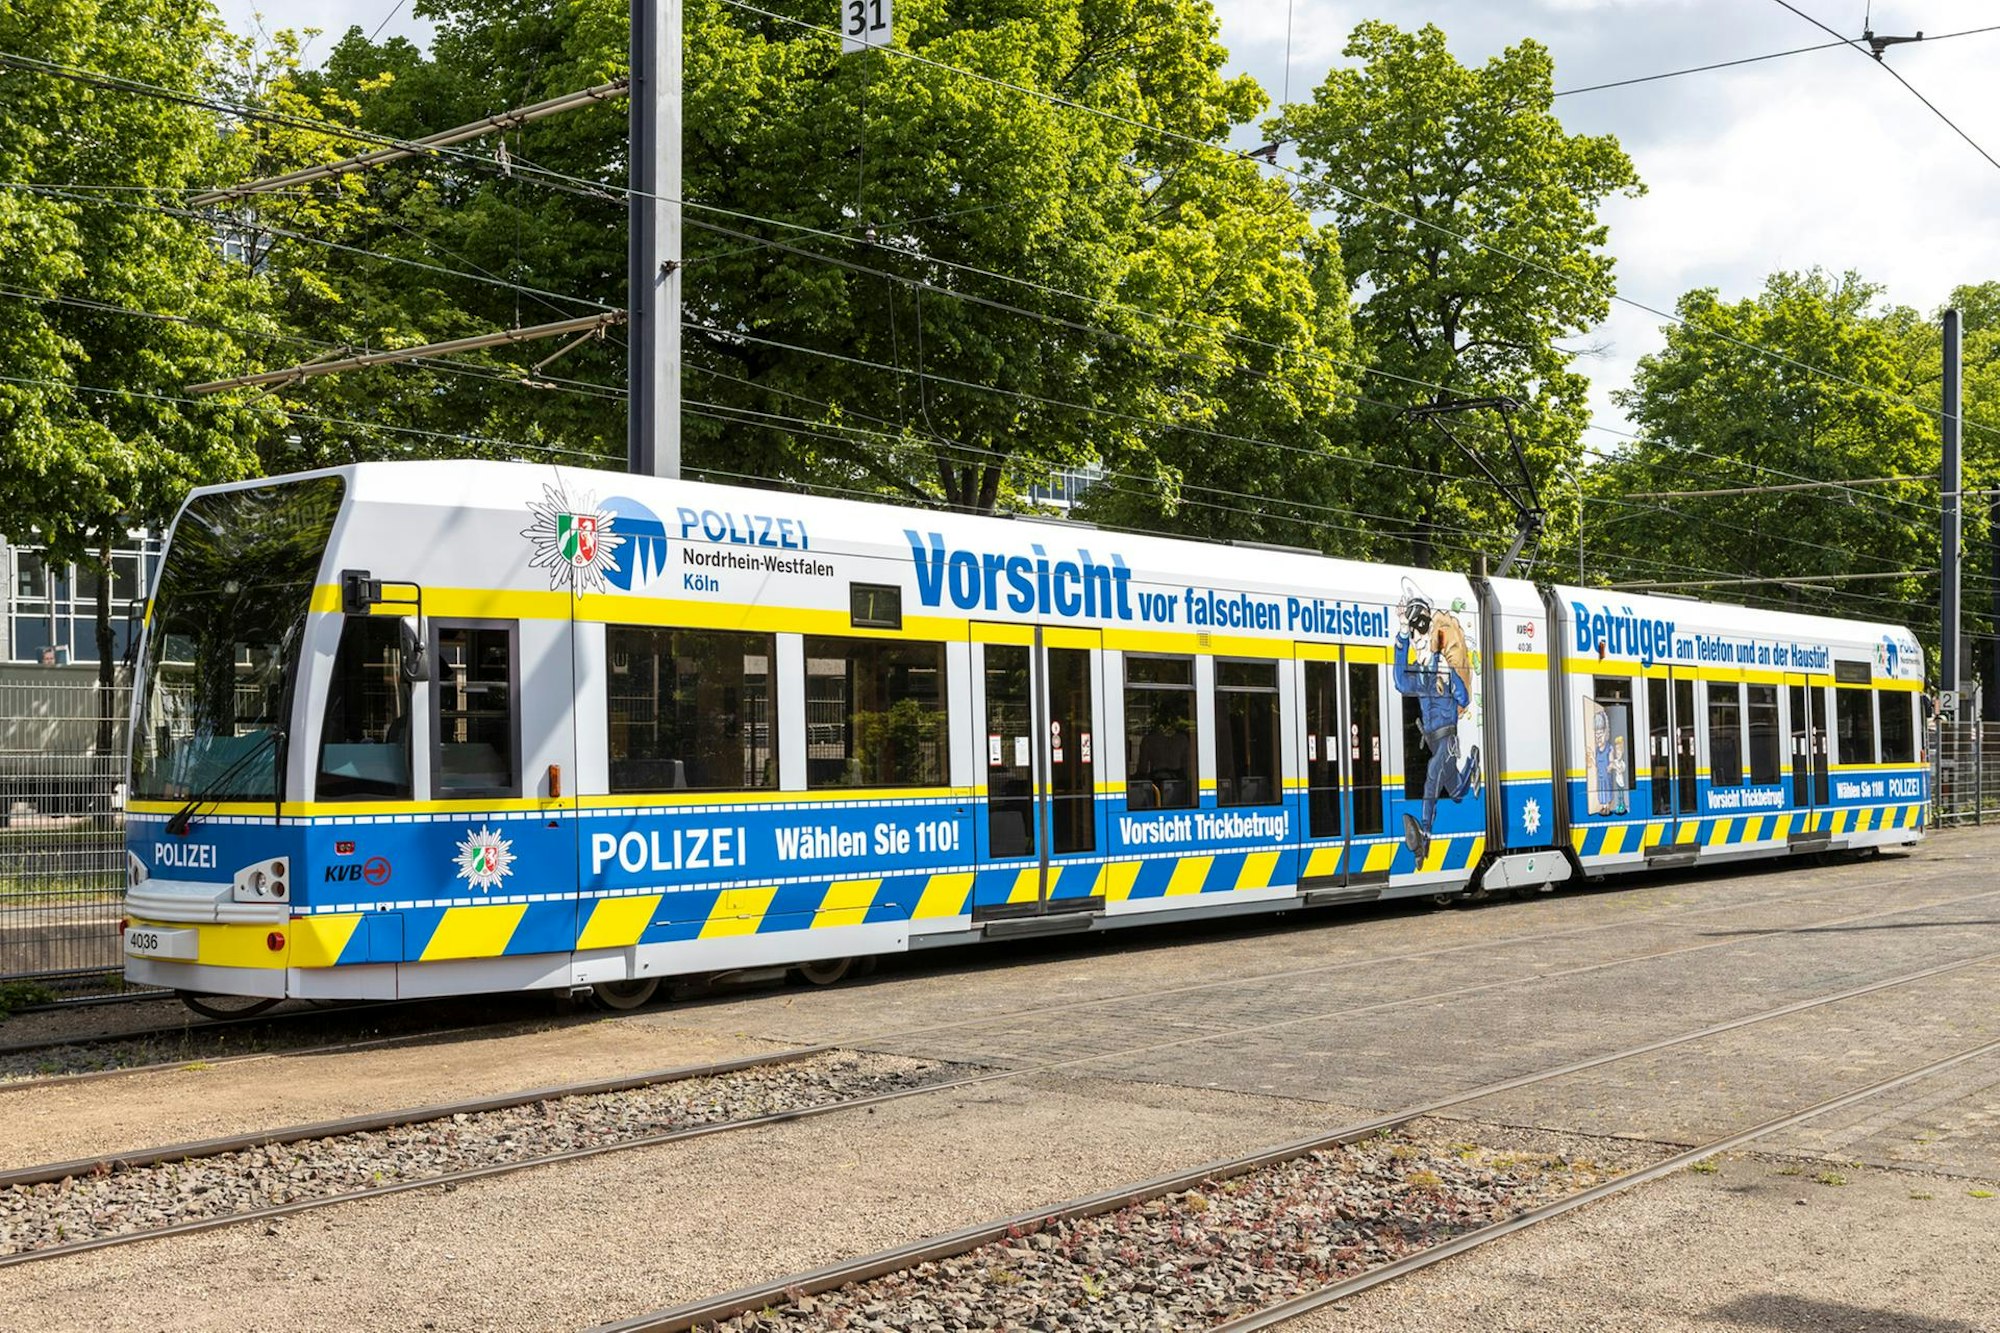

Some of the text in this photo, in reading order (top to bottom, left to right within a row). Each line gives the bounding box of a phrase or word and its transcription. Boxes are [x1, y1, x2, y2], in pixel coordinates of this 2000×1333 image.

[848, 0, 886, 36] 31
[677, 507, 809, 551] POLIZEI
[683, 547, 835, 577] Nordrhein-Westfalen
[683, 572, 719, 592] Köln
[904, 529, 1390, 638] Vorsicht vor falschen Polizisten!
[1571, 601, 1830, 669] Betrüger am Telefon und an der Haustür!
[1943, 693, 1952, 708] 2
[1707, 787, 1785, 809] Vorsicht Trickbetrug!
[1836, 782, 1859, 800] Wählen
[1860, 780, 1872, 798] Sie
[1888, 778, 1920, 798] POLIZEI
[775, 819, 960, 861] Wählen Sie 110!
[1119, 810, 1291, 847] Vorsicht Trickbetrug!
[155, 842, 217, 868] POLIZEI
[592, 826, 746, 875] POLIZEI
[325, 864, 362, 882] KVB
[130, 932, 158, 951] 4036
